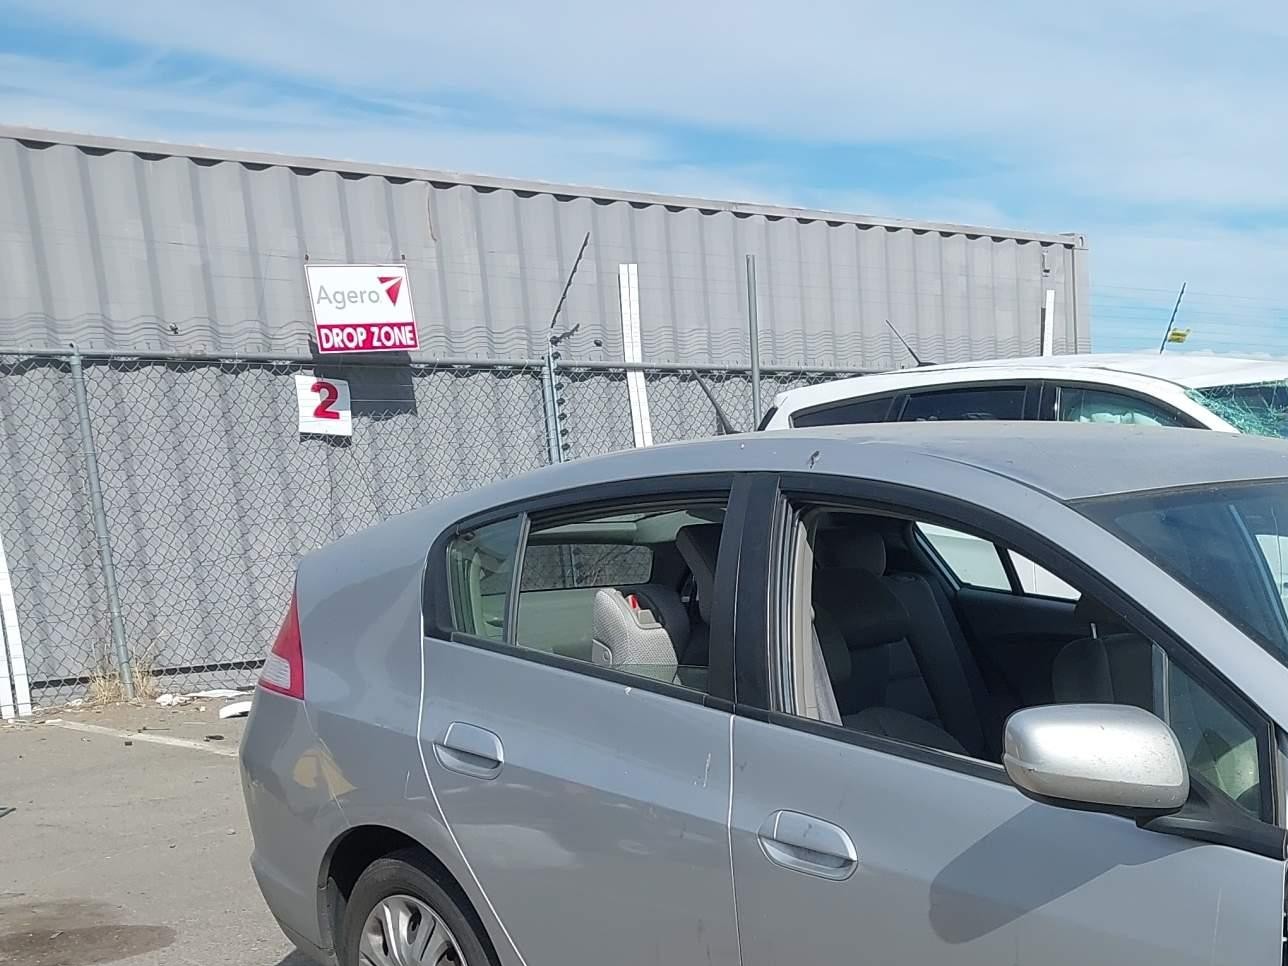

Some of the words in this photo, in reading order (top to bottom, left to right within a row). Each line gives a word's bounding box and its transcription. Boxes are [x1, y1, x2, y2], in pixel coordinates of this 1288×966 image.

[316, 285, 380, 310] Agero
[320, 327, 367, 349] DROP
[370, 326, 415, 347] ZONE
[310, 381, 340, 420] 2
